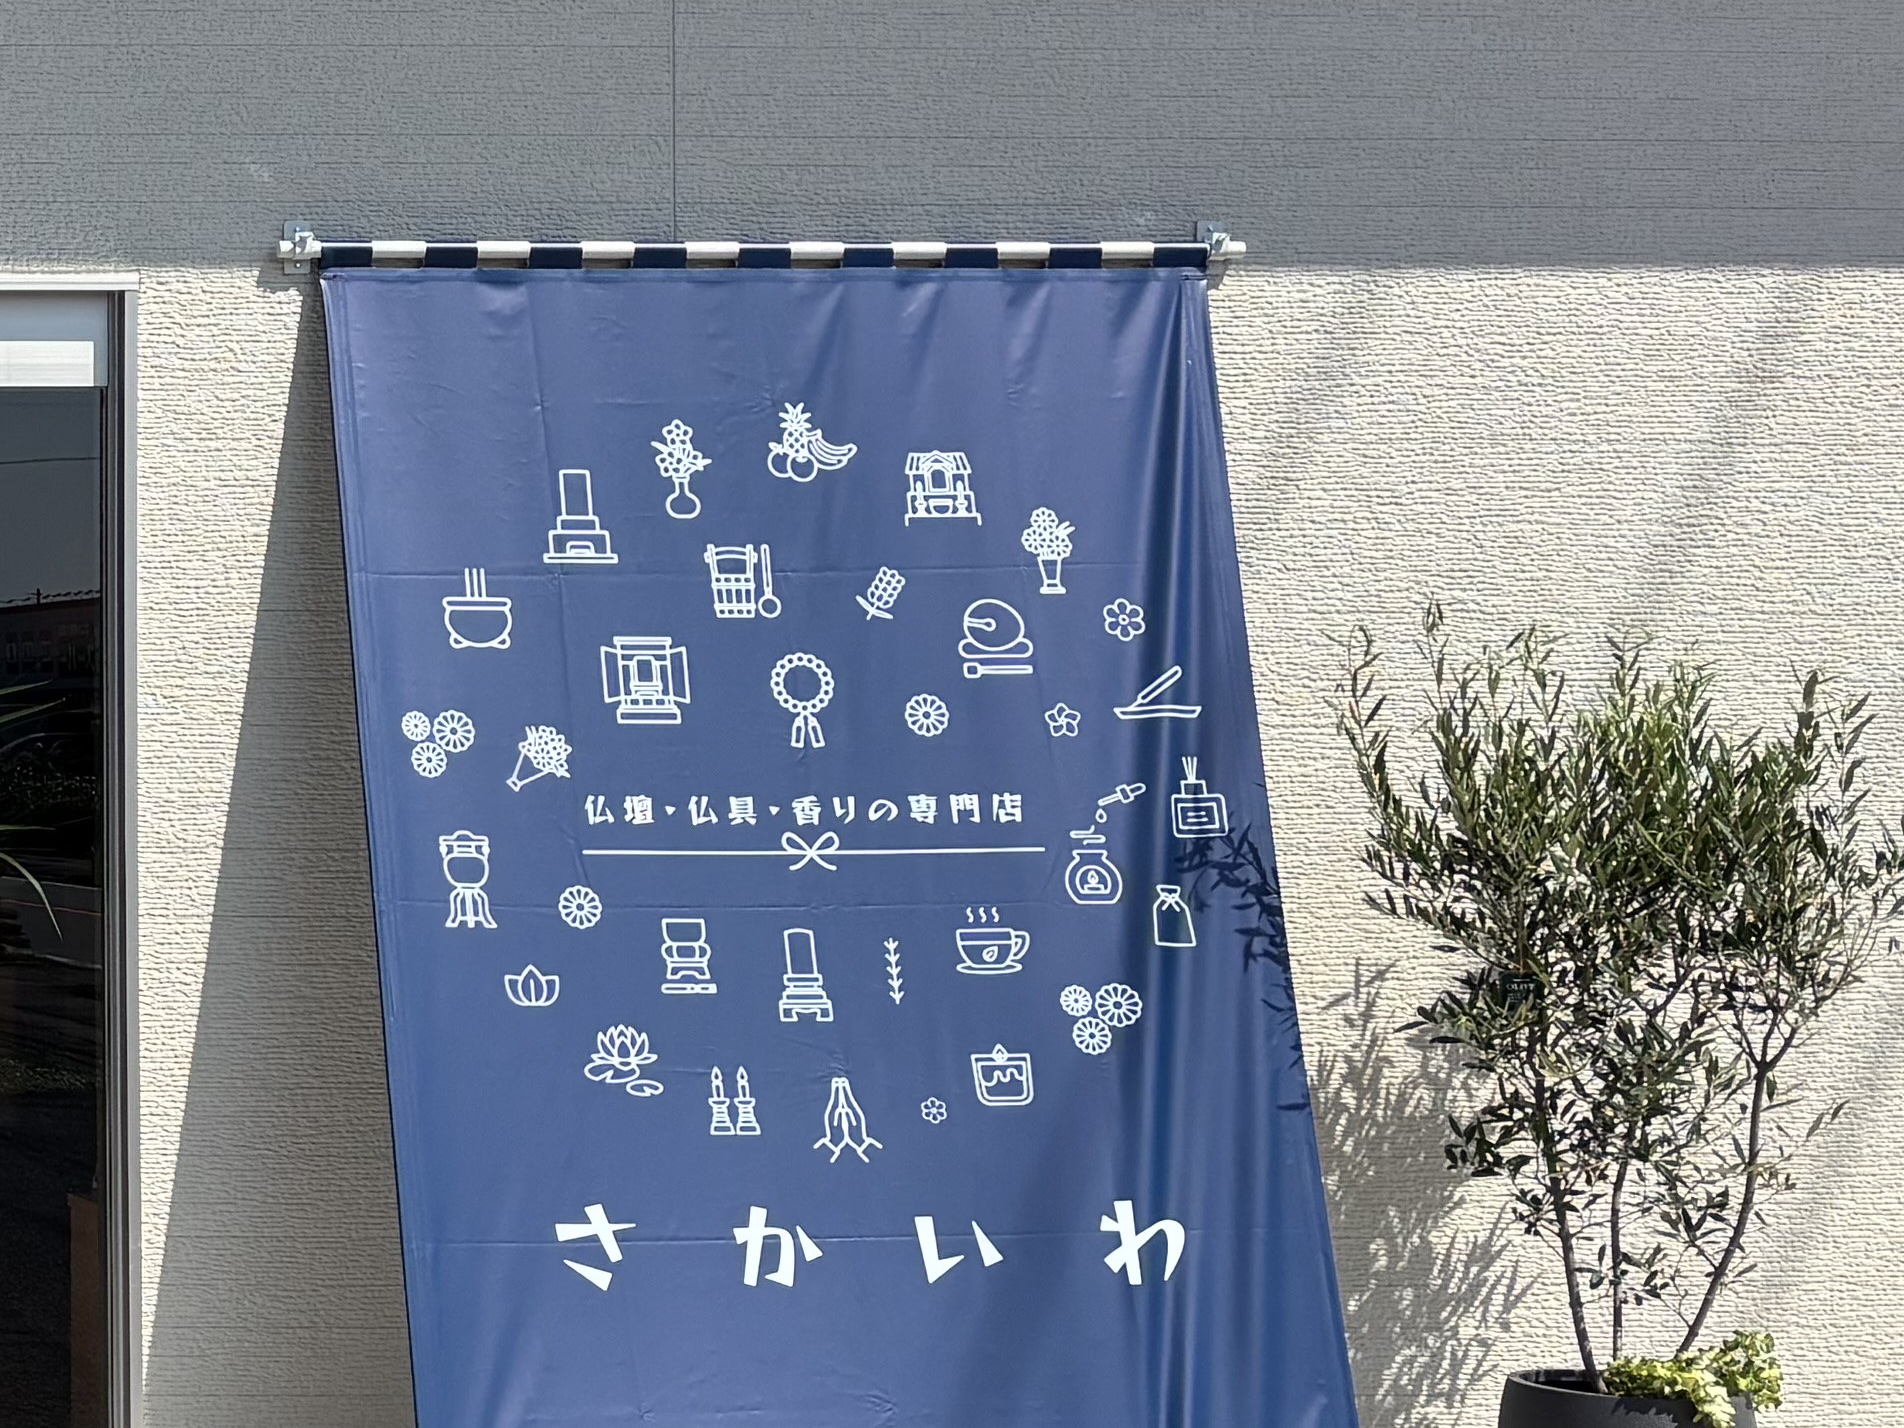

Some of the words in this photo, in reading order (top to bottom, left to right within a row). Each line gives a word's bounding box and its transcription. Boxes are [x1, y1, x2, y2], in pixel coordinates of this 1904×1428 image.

[584, 792, 1022, 826] 仏壇・仏具・香りの専門店
[554, 1199, 1186, 1292] さかいわ
